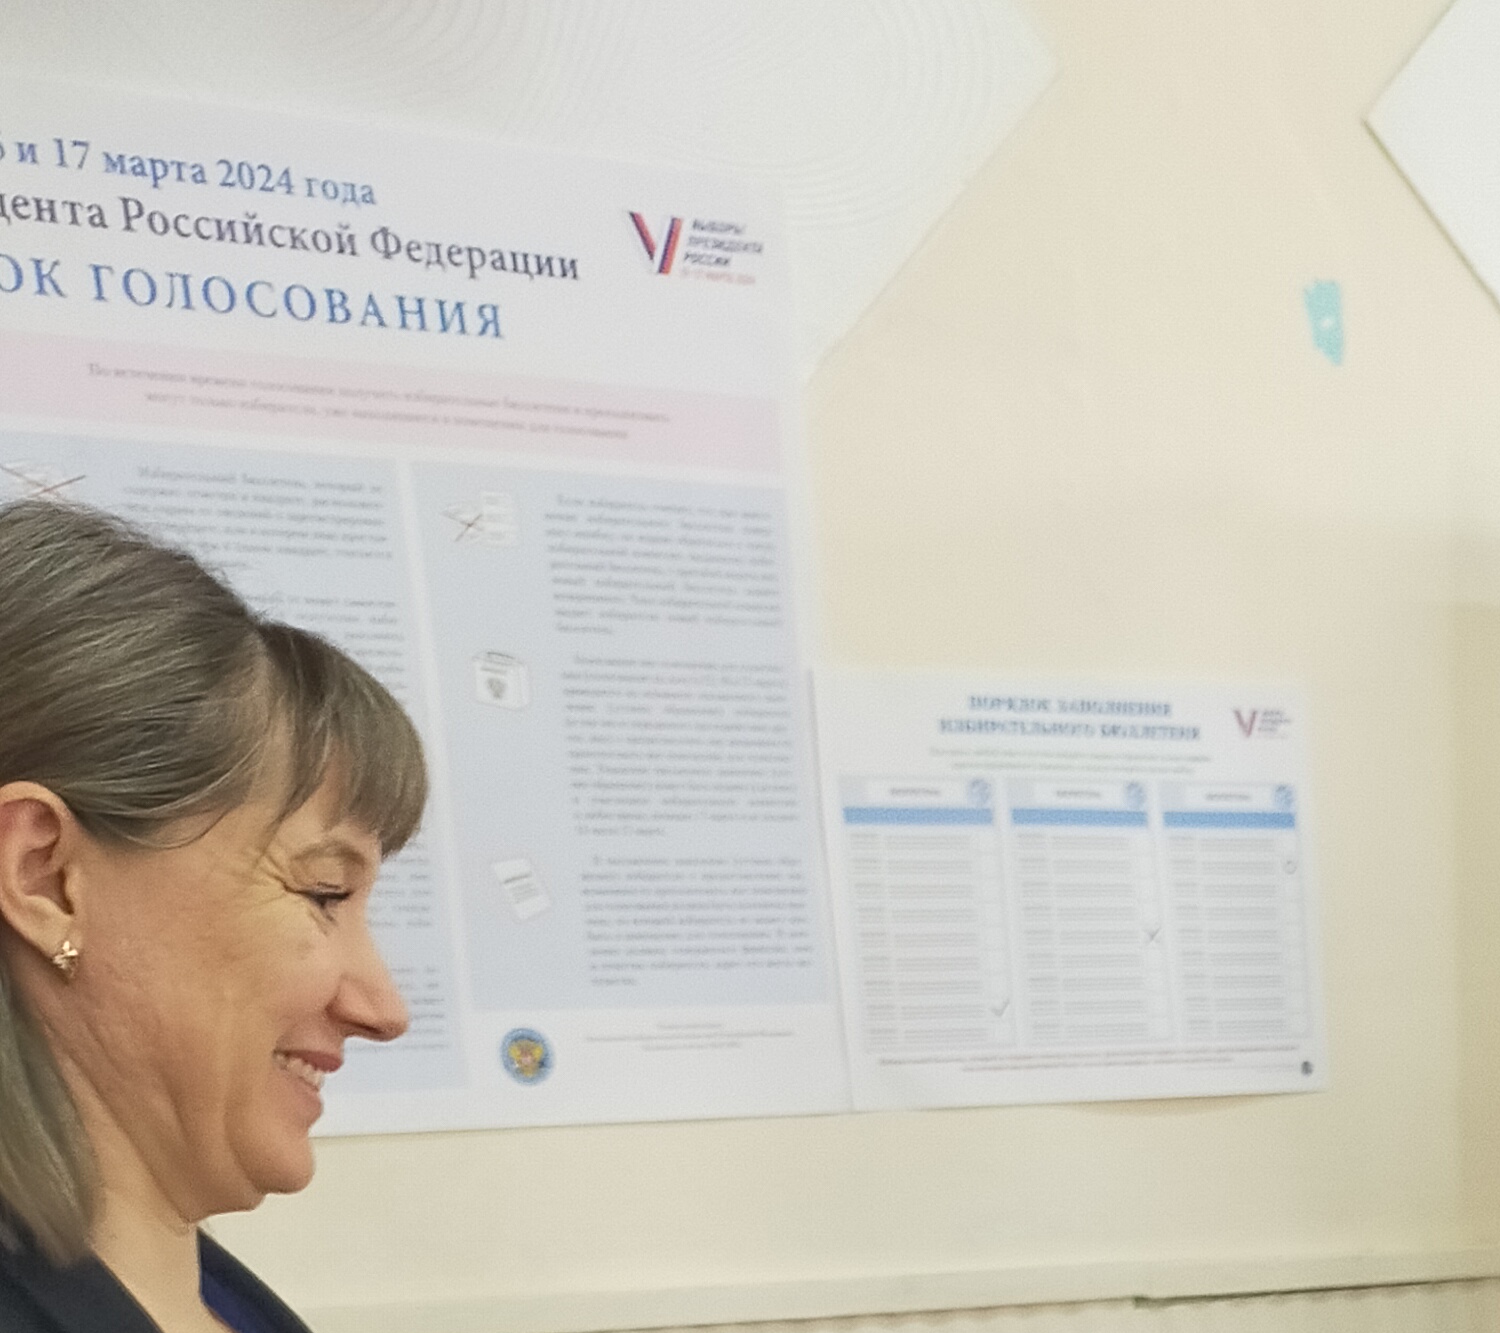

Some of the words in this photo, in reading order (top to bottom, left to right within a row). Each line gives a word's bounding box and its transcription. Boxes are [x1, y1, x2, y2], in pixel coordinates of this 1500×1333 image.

[16, 141, 39, 164] и
[52, 138, 91, 170] 17
[102, 151, 208, 188] марта
[215, 159, 294, 195] 2024
[304, 175, 377, 205] года
[118, 196, 358, 256] Российской
[370, 225, 579, 280] Федерации
[89, 263, 503, 338] ГОЛОСОВАНИЯ
